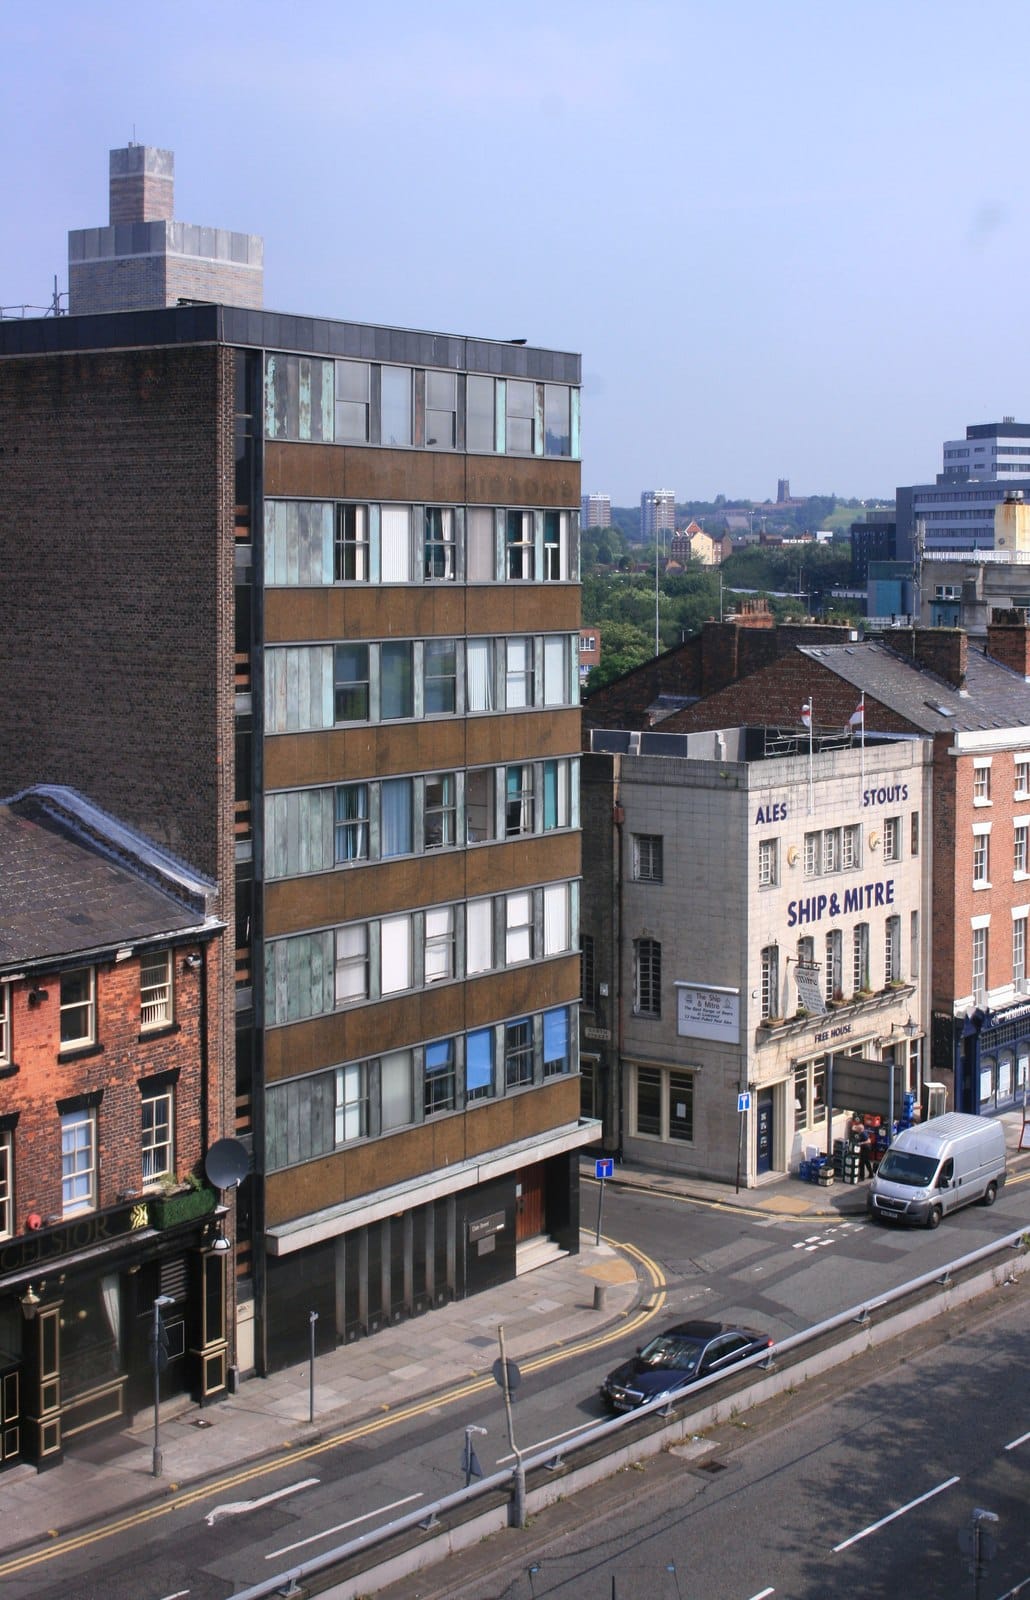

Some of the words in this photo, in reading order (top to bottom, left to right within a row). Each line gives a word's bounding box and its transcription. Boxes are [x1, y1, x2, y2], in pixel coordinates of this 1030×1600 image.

[863, 784, 908, 807] STOUTS
[755, 803, 787, 825] ALES
[815, 1030, 830, 1044] FREE
[830, 1023, 852, 1038] HOUSE
